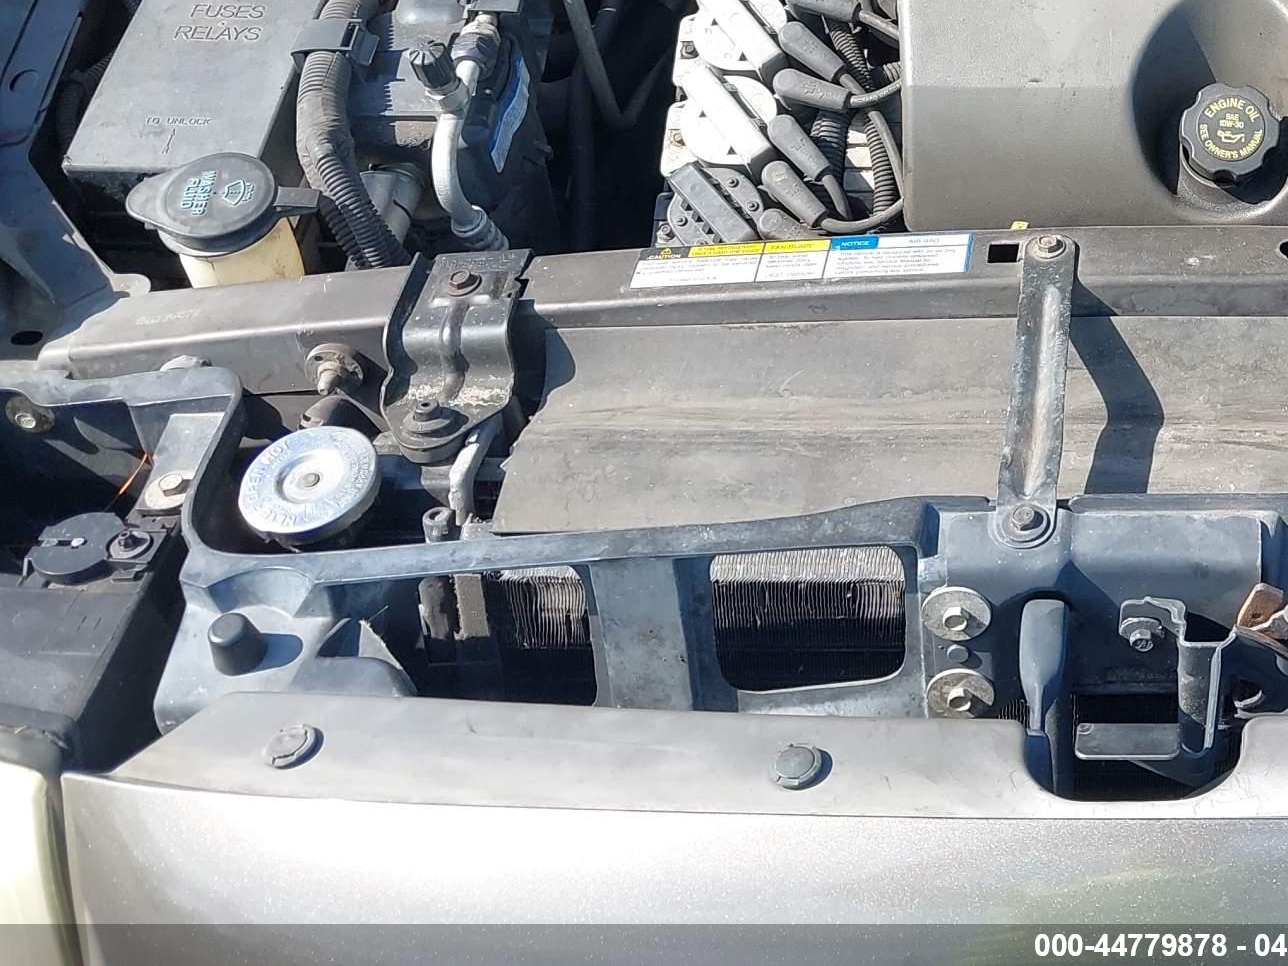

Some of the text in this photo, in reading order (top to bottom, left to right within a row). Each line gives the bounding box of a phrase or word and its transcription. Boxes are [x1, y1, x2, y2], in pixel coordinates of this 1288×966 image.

[189, 4, 267, 18] FUSES
[174, 25, 261, 41] RELAYS
[166, 116, 215, 125] UNLOCK
[1204, 97, 1261, 123] ENGINE OIL
[1199, 123, 1263, 159] SEE OWNER'S MANUAL
[180, 177, 201, 210] FLUID
[192, 170, 219, 217] WASHER
